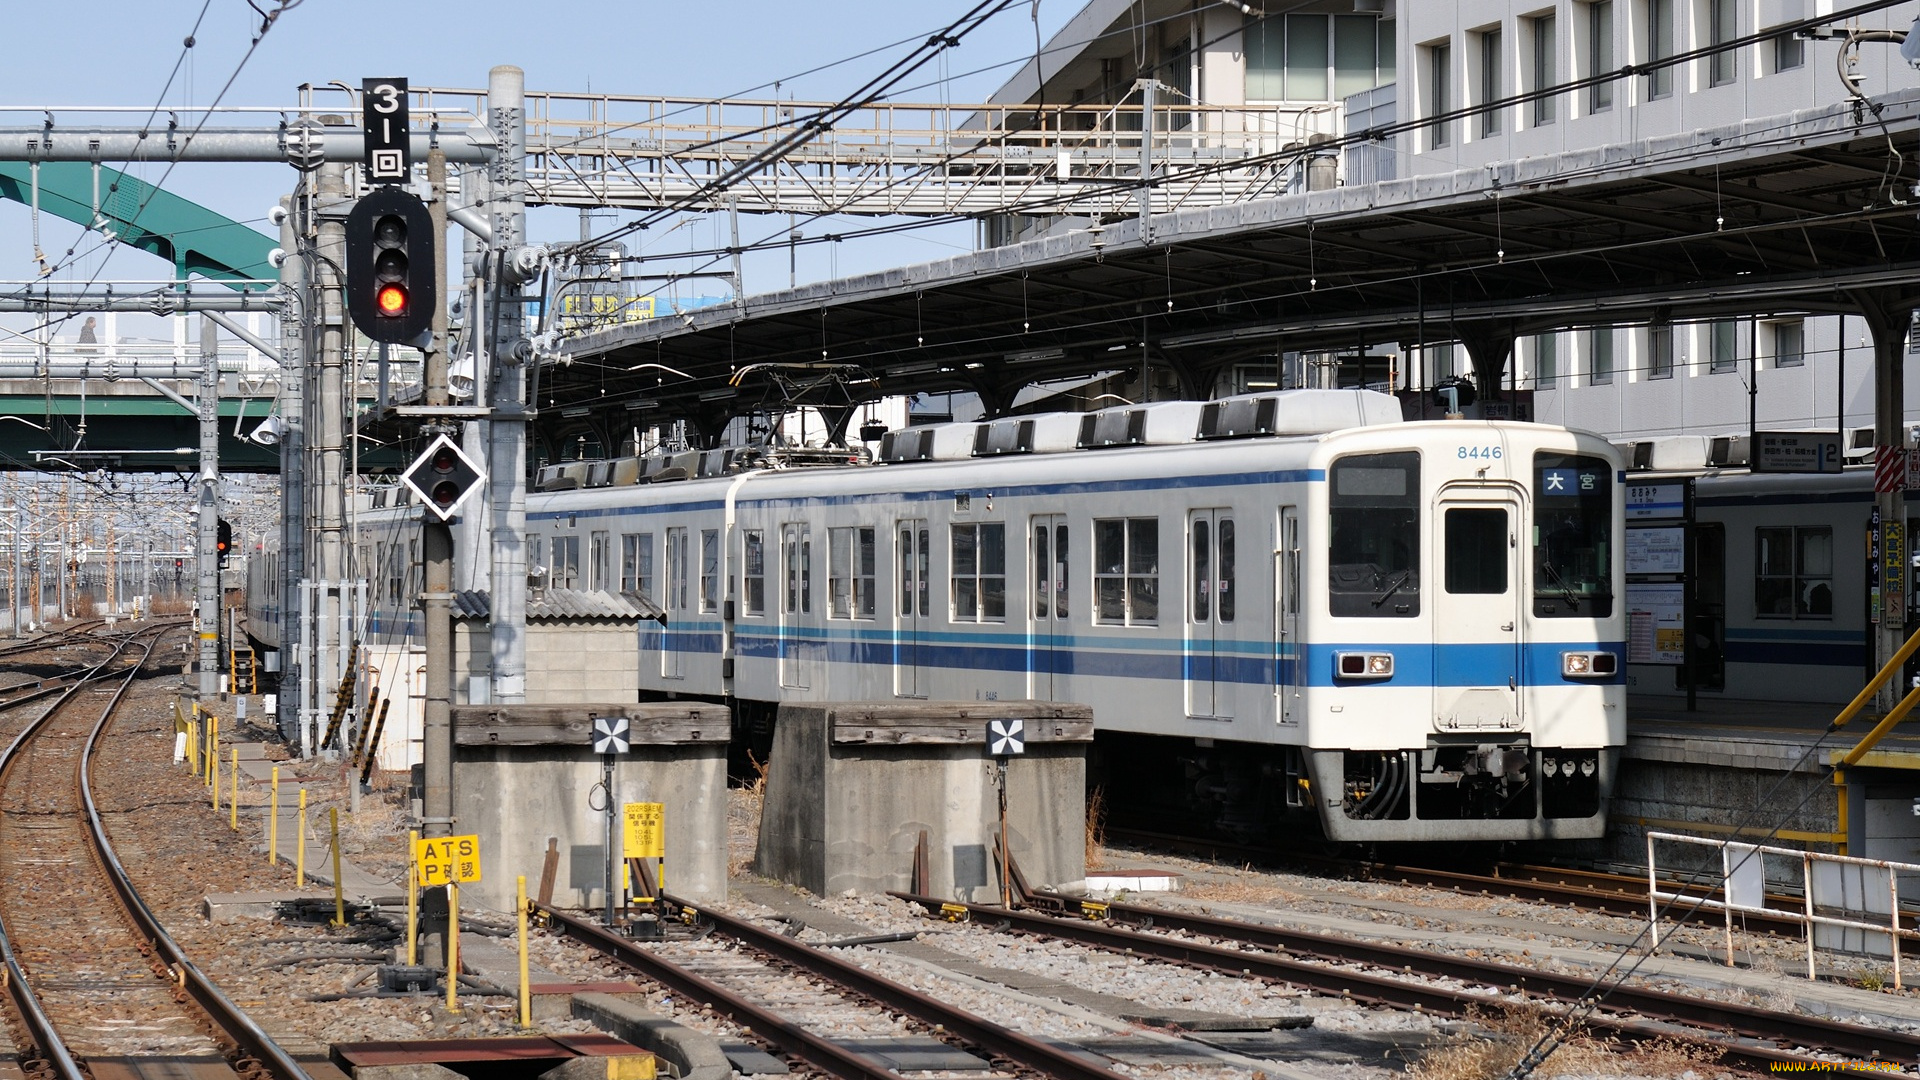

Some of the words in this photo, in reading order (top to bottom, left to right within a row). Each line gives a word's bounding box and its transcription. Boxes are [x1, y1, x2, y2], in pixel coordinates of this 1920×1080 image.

[1457, 446, 1502, 459] 8446
[1825, 443, 1837, 462] 2
[1547, 472, 1596, 490] 大宮
[424, 840, 473, 860] ATS
[425, 864, 438, 881] P
